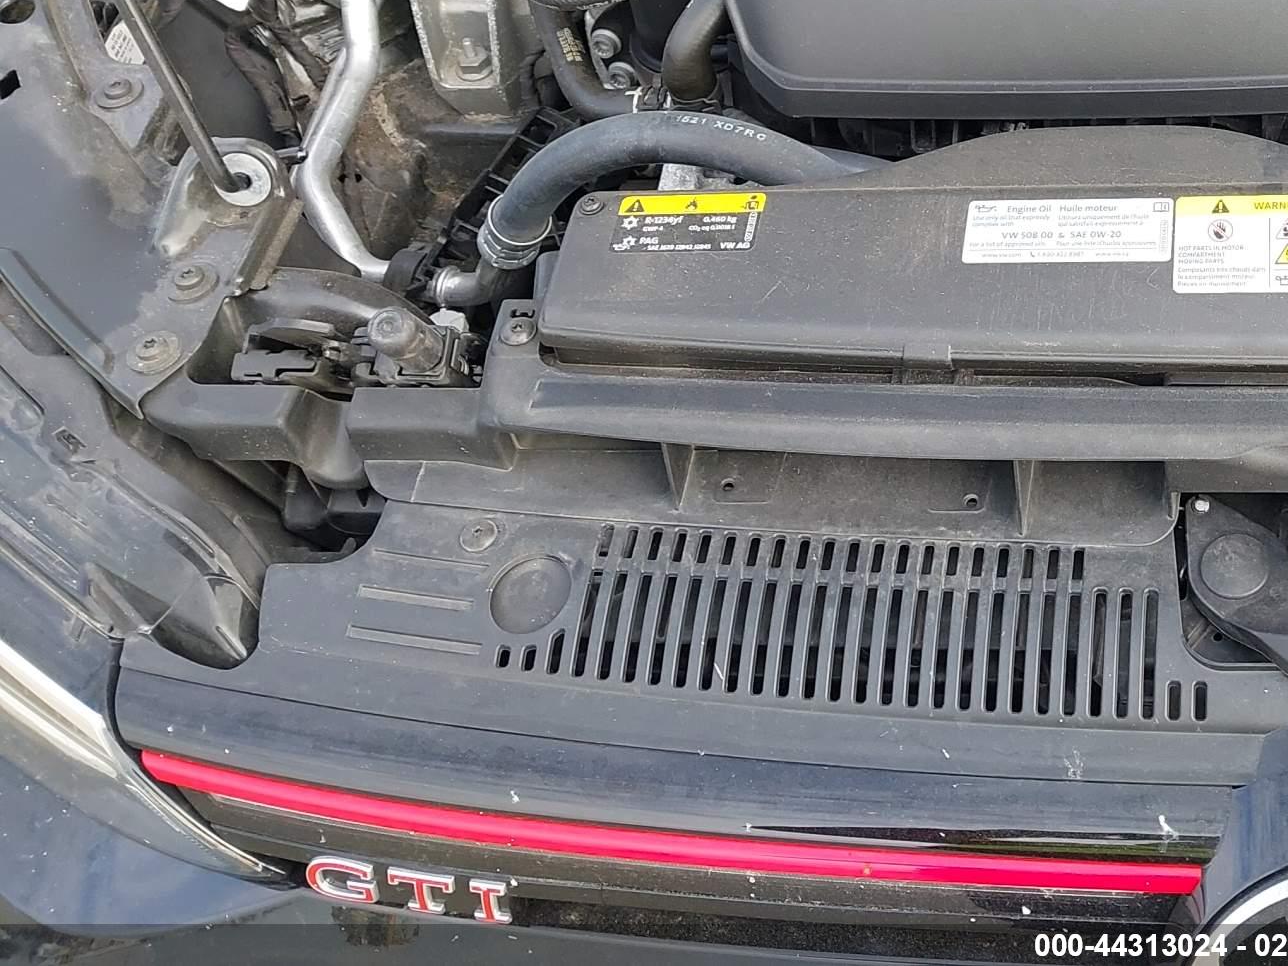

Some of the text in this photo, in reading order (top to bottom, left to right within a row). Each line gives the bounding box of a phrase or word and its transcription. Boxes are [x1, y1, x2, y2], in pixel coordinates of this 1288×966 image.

[1007, 205, 1037, 215] Engine
[1039, 204, 1052, 213] Oil
[1059, 204, 1083, 212] Huile
[645, 216, 684, 225] R-1234yf
[726, 216, 737, 224] kg
[1001, 231, 1019, 240] VW
[1020, 231, 1039, 239] 508
[1040, 231, 1054, 239] 00
[1070, 230, 1088, 239] SAE
[1090, 230, 1123, 239] 0W-20
[639, 236, 659, 245] PAG
[720, 241, 751, 250] VW AG
[306, 855, 513, 924] GTI
